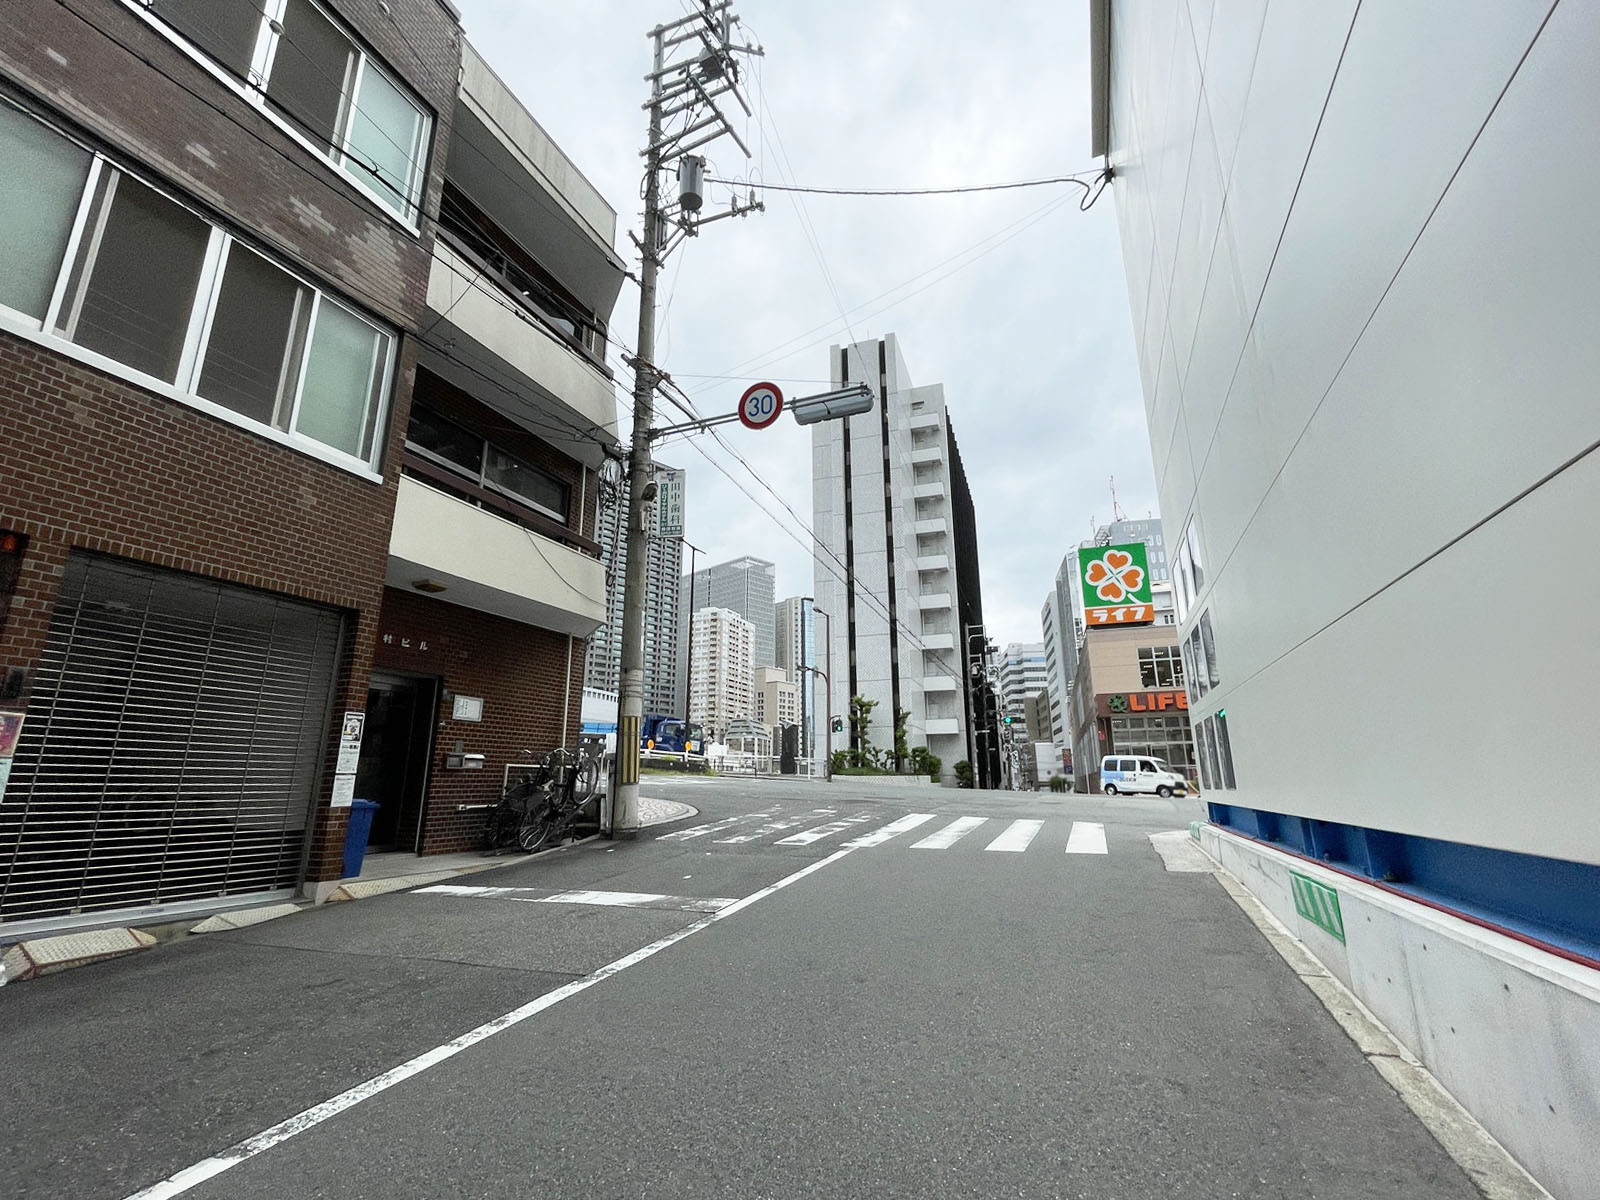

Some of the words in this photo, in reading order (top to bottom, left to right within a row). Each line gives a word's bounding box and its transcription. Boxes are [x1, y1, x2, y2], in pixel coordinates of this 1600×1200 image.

[748, 394, 773, 417] 30
[1092, 606, 1146, 622] ライフ
[1129, 692, 1188, 711] LIFE
